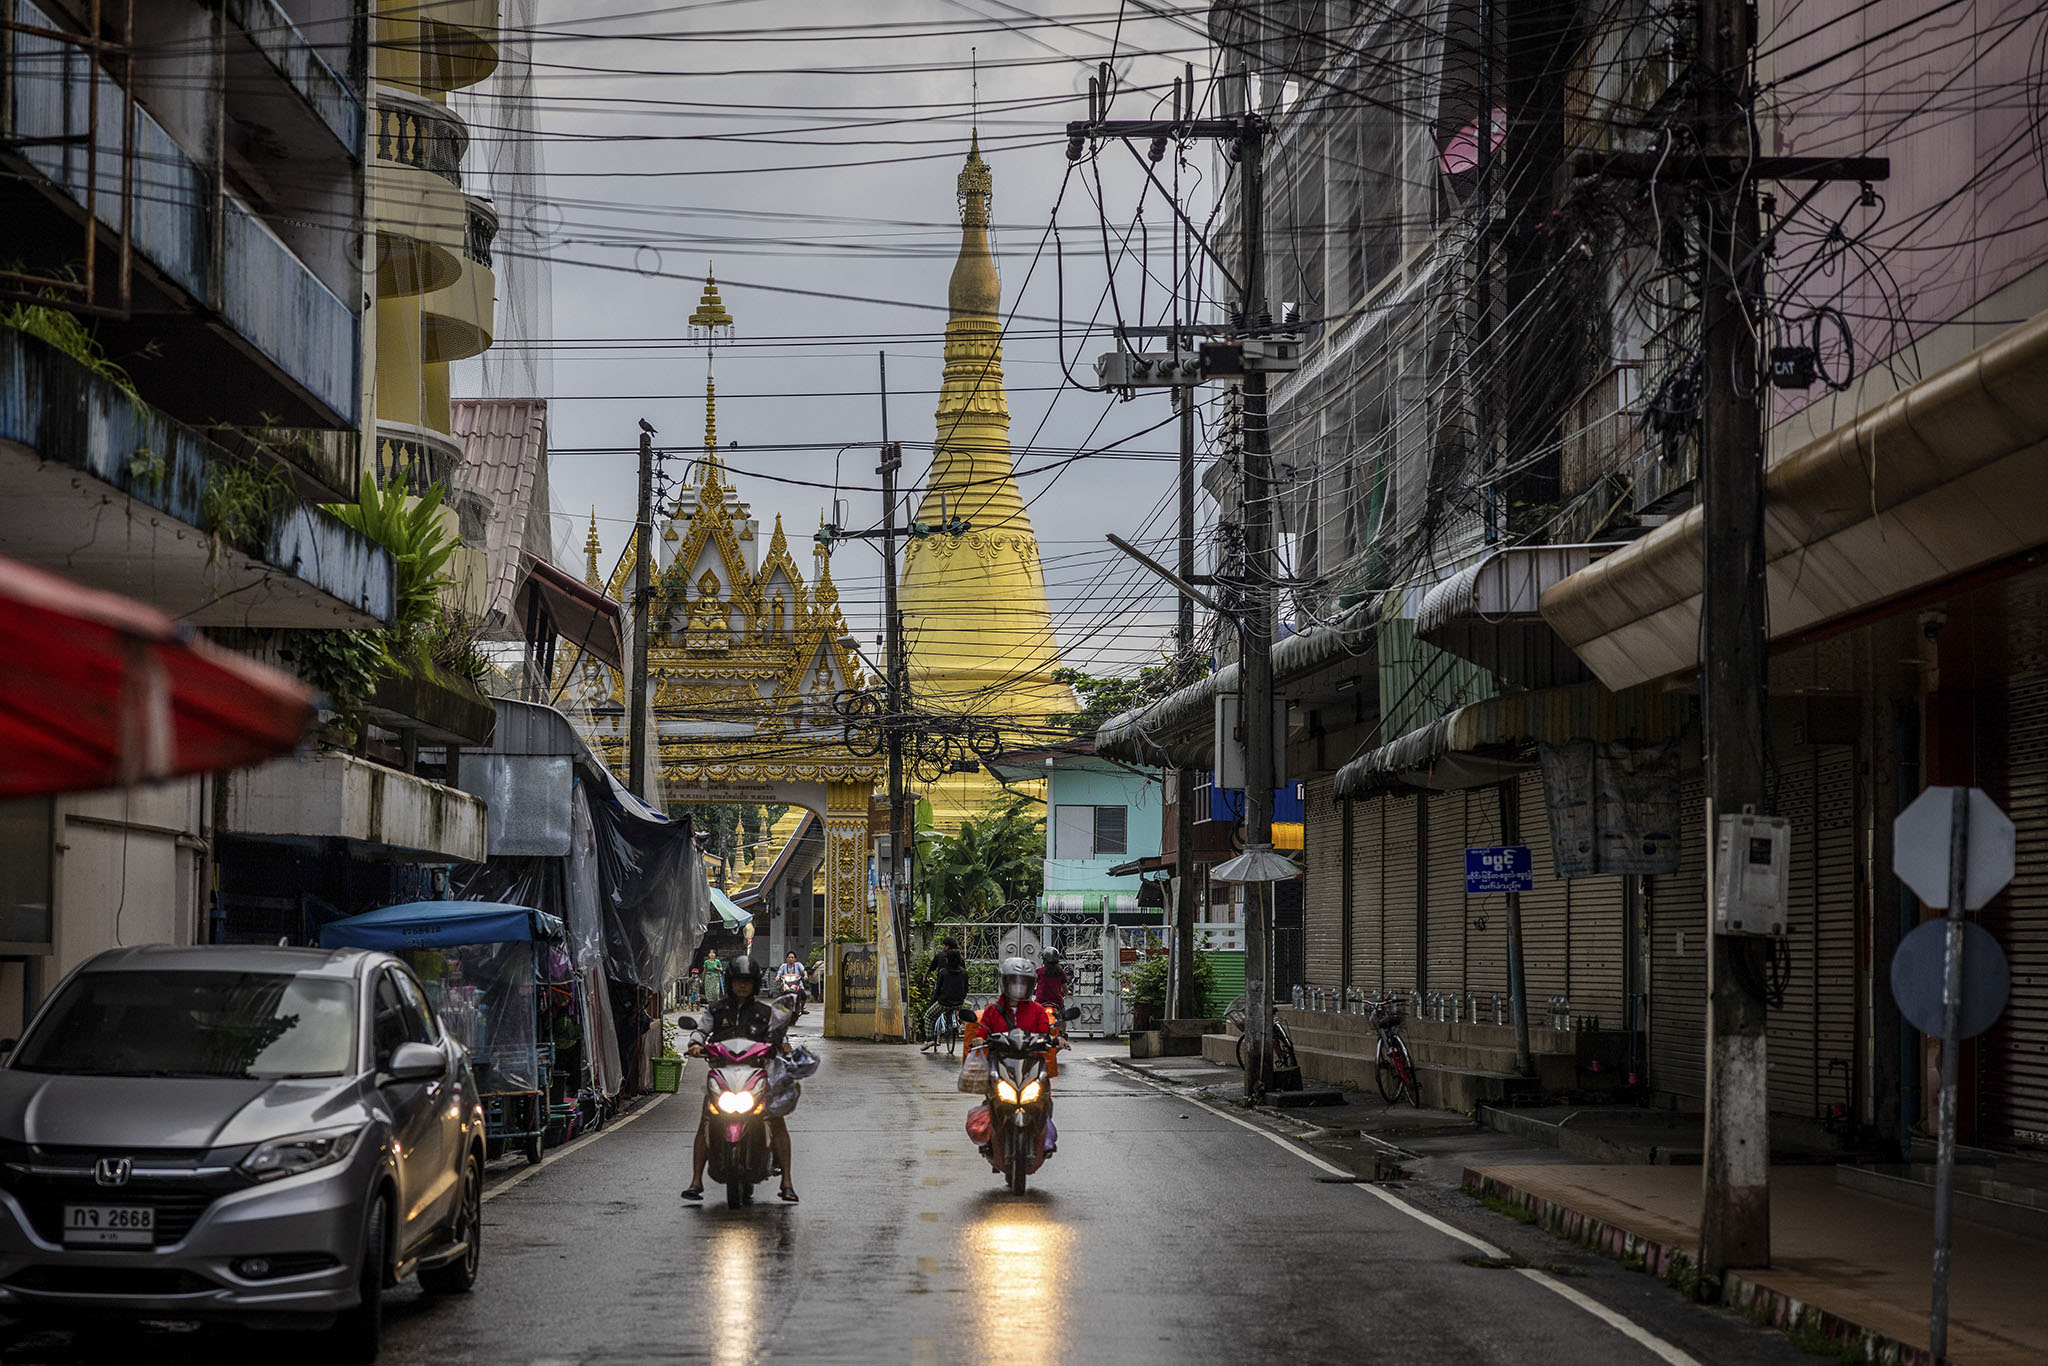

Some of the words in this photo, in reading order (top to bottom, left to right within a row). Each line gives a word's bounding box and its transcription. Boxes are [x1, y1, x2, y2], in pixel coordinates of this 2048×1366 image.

[1774, 361, 1795, 376] CAT
[74, 1208, 99, 1226] กจ
[109, 1209, 151, 1227] 2668
